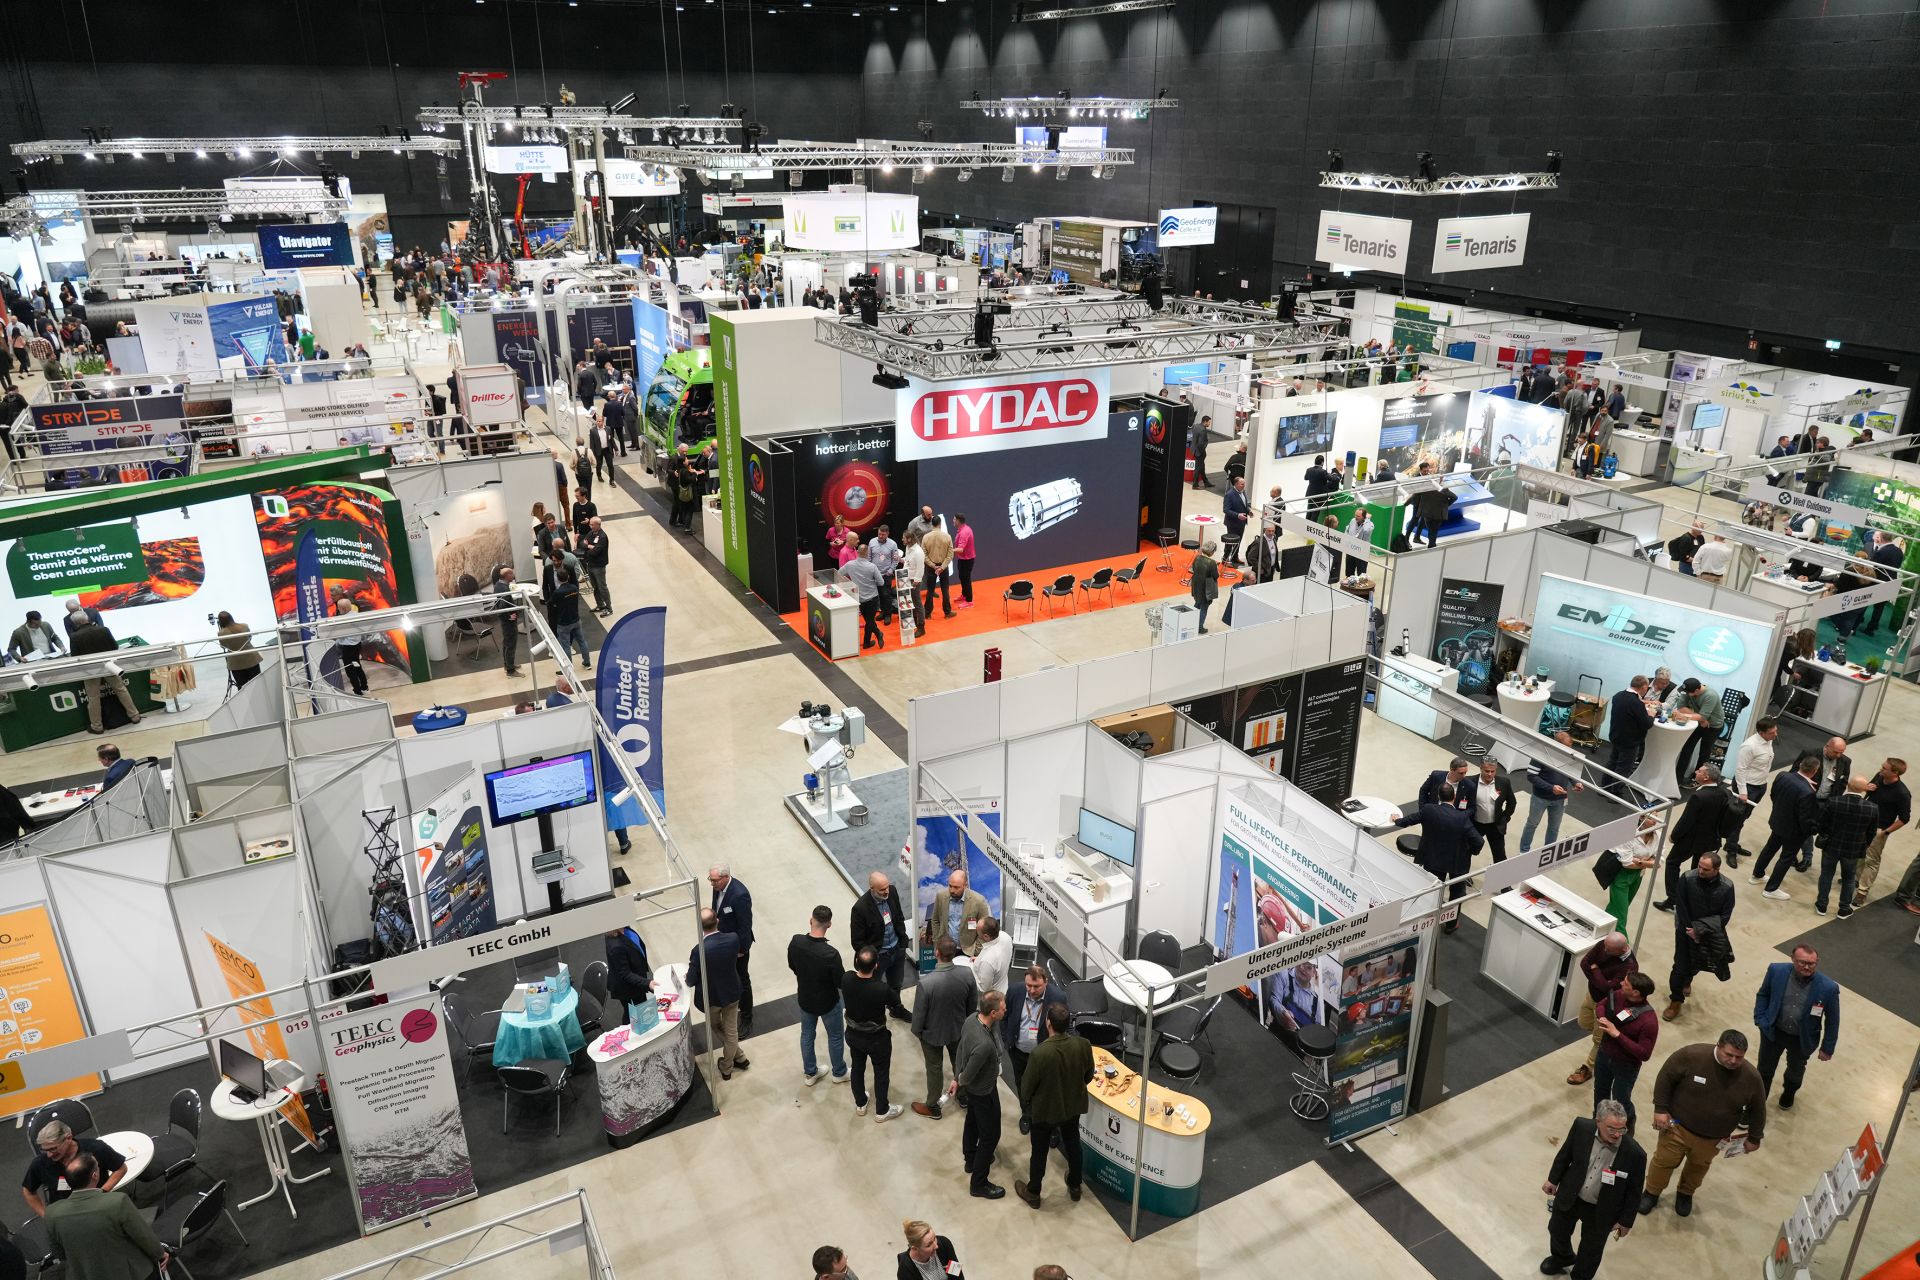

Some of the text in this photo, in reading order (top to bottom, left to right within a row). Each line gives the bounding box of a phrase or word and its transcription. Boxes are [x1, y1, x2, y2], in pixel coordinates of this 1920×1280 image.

[1179, 218, 1216, 227] GeoEnergy
[279, 235, 332, 248] tNavigator
[1343, 234, 1396, 258] Tenaris
[1463, 235, 1516, 256] Tenaris
[254, 302, 273, 311] VULCAN
[255, 309, 273, 318] ENERGY
[471, 393, 506, 403] DrillTec
[1721, 390, 1744, 400] sirius
[347, 402, 369, 410] OILFIELD
[923, 382, 1089, 438] HYDAC
[815, 444, 850, 456] hotter
[857, 440, 891, 451] better
[1793, 496, 1832, 514] Well Guidance
[1306, 525, 1341, 543] BESTEC GmbH
[30, 552, 133, 571] damit die Wärme
[332, 547, 381, 563] überragender
[33, 562, 127, 581] oben ankommt.
[1441, 612, 1486, 623] DRILLING TOOLS
[1557, 603, 1676, 645] EMDE
[1608, 632, 1666, 652] BOHRTECHNIK
[616, 660, 633, 720] United
[633, 654, 650, 720] Rentals
[1230, 804, 1359, 903] FULL LIFECYCLE PERFORMANCE
[985, 832, 1059, 909] Untergrundspeicher- und
[985, 847, 1059, 924] Geotechnologie-Systeme
[1266, 872, 1300, 901] ENGINEERING
[1420, 918, 1434, 930] 017
[1440, 911, 1455, 922] 016
[467, 926, 552, 958] TEEC GmbH
[1248, 912, 1369, 966] Untergrundspeicher- und
[1246, 930, 1367, 980] Geotechnologie-Systeme
[285, 1018, 309, 1035] 019
[331, 1018, 394, 1045] TEEC
[335, 1034, 396, 1057] Geophysics
[339, 1075, 369, 1086] Prestack
[370, 1070, 387, 1078] Time
[394, 1062, 414, 1072] Depth
[415, 1053, 446, 1066] Migration
[354, 1065, 435, 1092] Seismic Data Processing
[358, 1074, 435, 1099] Full Wavefield Migration
[367, 1084, 429, 1106] Diffraction Imaging
[374, 1093, 426, 1113] CRS Processing
[394, 1107, 410, 1115] RTM
[1079, 1124, 1165, 1177] PERTISE BY EXPEIENCE
